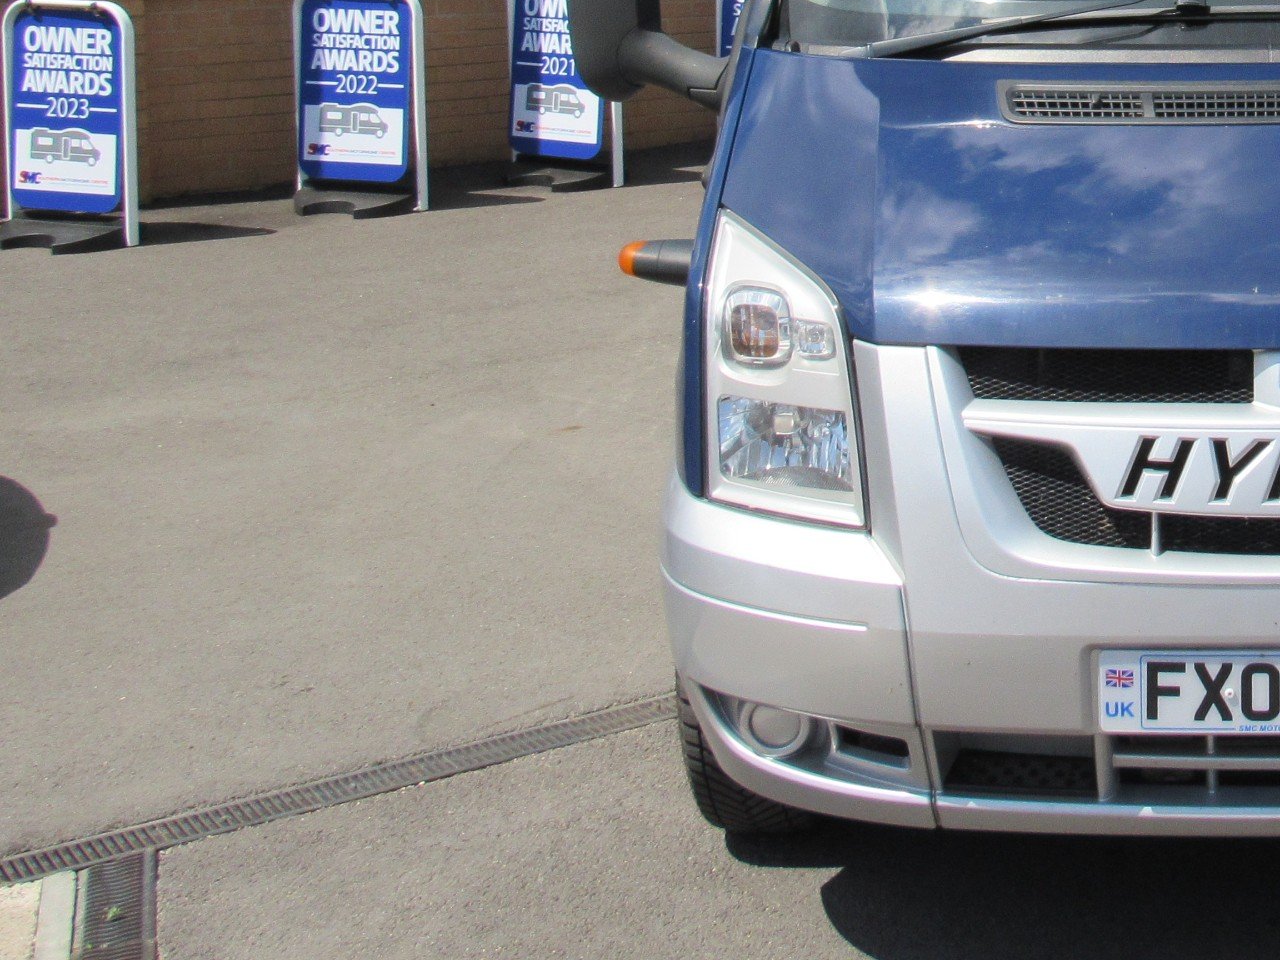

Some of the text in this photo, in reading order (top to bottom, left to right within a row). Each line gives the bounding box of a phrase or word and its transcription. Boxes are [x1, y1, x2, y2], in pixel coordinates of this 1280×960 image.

[313, 8, 399, 34] OWNER
[24, 25, 112, 55] OWNER
[313, 33, 400, 50] SATISFACTION
[23, 52, 112, 72] SATISFACTION
[311, 49, 400, 73] AWARDS
[541, 56, 575, 76] 2021
[21, 69, 112, 96] AWARDS
[336, 74, 377, 94] 2022
[46, 97, 90, 119] 2023
[307, 143, 331, 156] SMC
[18, 170, 42, 185] SMC
[1105, 701, 1134, 718] UK
